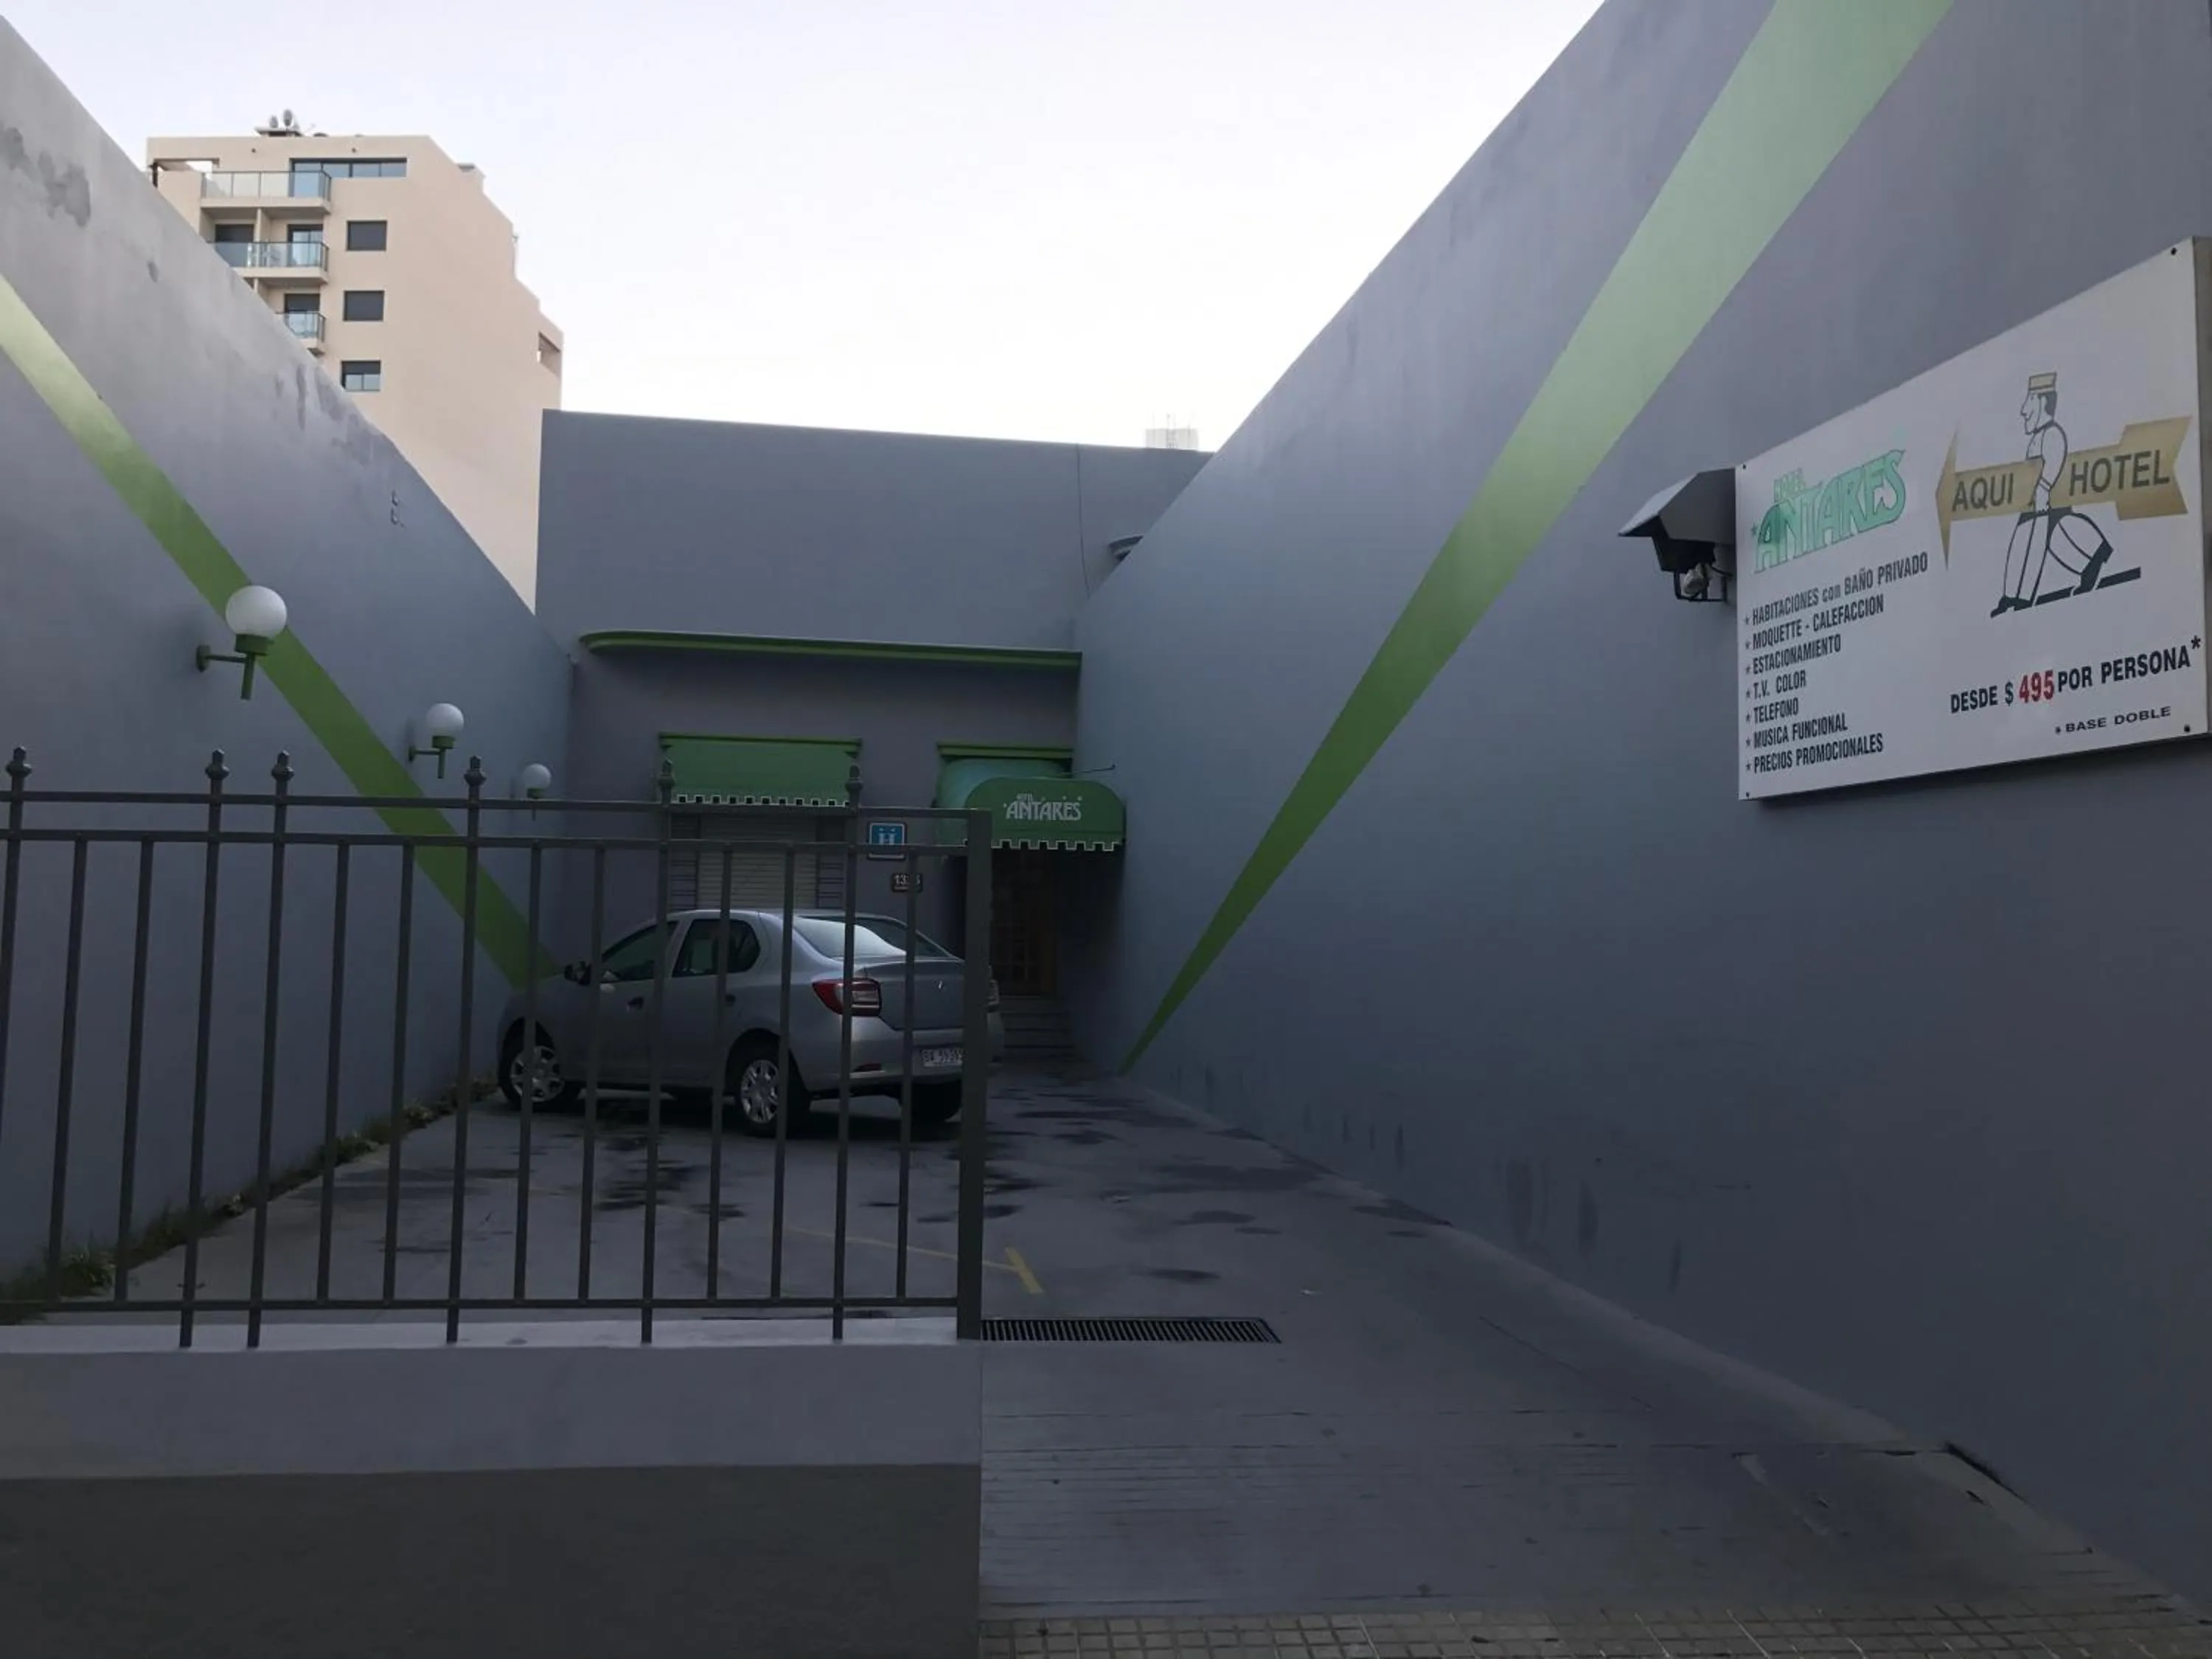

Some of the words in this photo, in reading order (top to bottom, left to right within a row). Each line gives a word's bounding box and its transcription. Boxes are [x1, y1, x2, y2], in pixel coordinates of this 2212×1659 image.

[1952, 473, 2014, 512] AQUI
[2069, 450, 2170, 496] HOTEL
[1754, 449, 1906, 574] ANTARES
[1753, 588, 1819, 625] HABITACIONES
[1822, 585, 1841, 602] con
[1844, 568, 1874, 596] BAÑO
[1877, 552, 1928, 585] PRIVADO
[1753, 619, 1802, 650] MOQUETTE
[1813, 594, 1884, 632] CALEFACCION
[1753, 633, 1841, 674] ESTACIONAMIENTO
[1753, 680, 1770, 700] T.V.
[1775, 669, 1806, 694] COLOR
[1950, 686, 1997, 714] DESDE
[2019, 669, 2055, 703] 495
[2058, 666, 2093, 692] POR
[2101, 645, 2191, 684] PERSONA
[1753, 698, 1799, 724] TELEFONO
[1753, 727, 1790, 749] MUSICA
[1792, 713, 1848, 740] FUNCIONAL
[2065, 718, 2107, 733] BASE
[2115, 706, 2171, 726] DOBLE
[1754, 751, 1792, 774] PRECIOS
[1795, 733, 1883, 765] PROMOCIONALES
[1005, 801, 1082, 821] ANTARES
